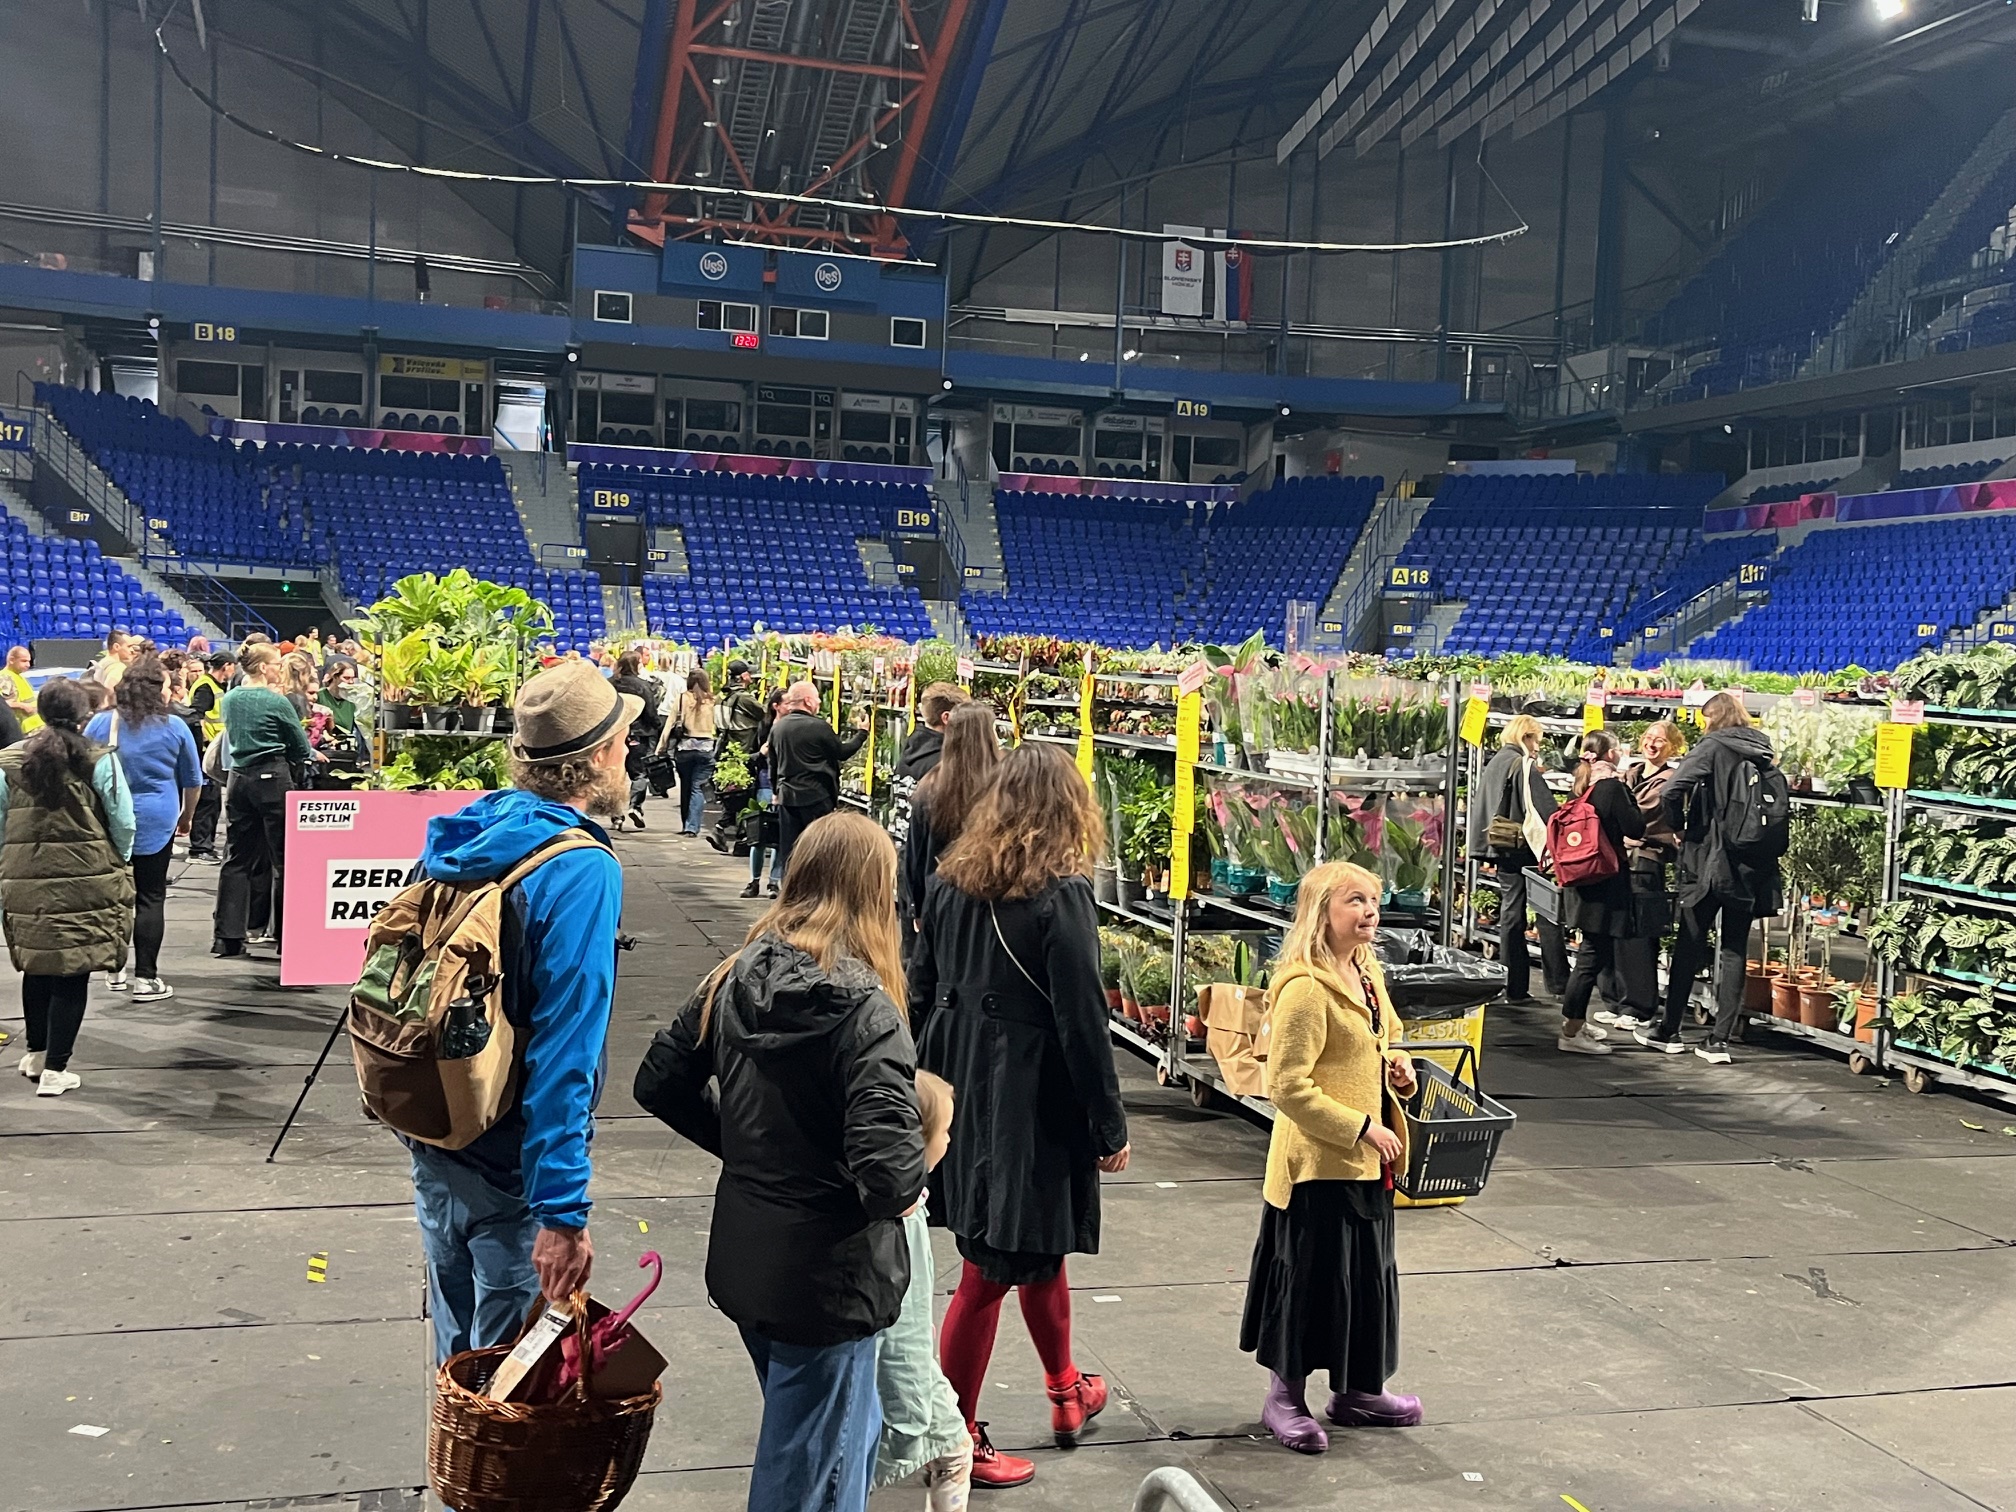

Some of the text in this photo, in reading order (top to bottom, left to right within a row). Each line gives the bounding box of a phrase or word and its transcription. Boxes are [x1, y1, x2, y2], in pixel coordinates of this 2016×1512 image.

[703, 260, 724, 274] USS
[818, 270, 838, 285] USS
[0, 424, 24, 442] 17
[300, 802, 357, 812] FESTIVAL
